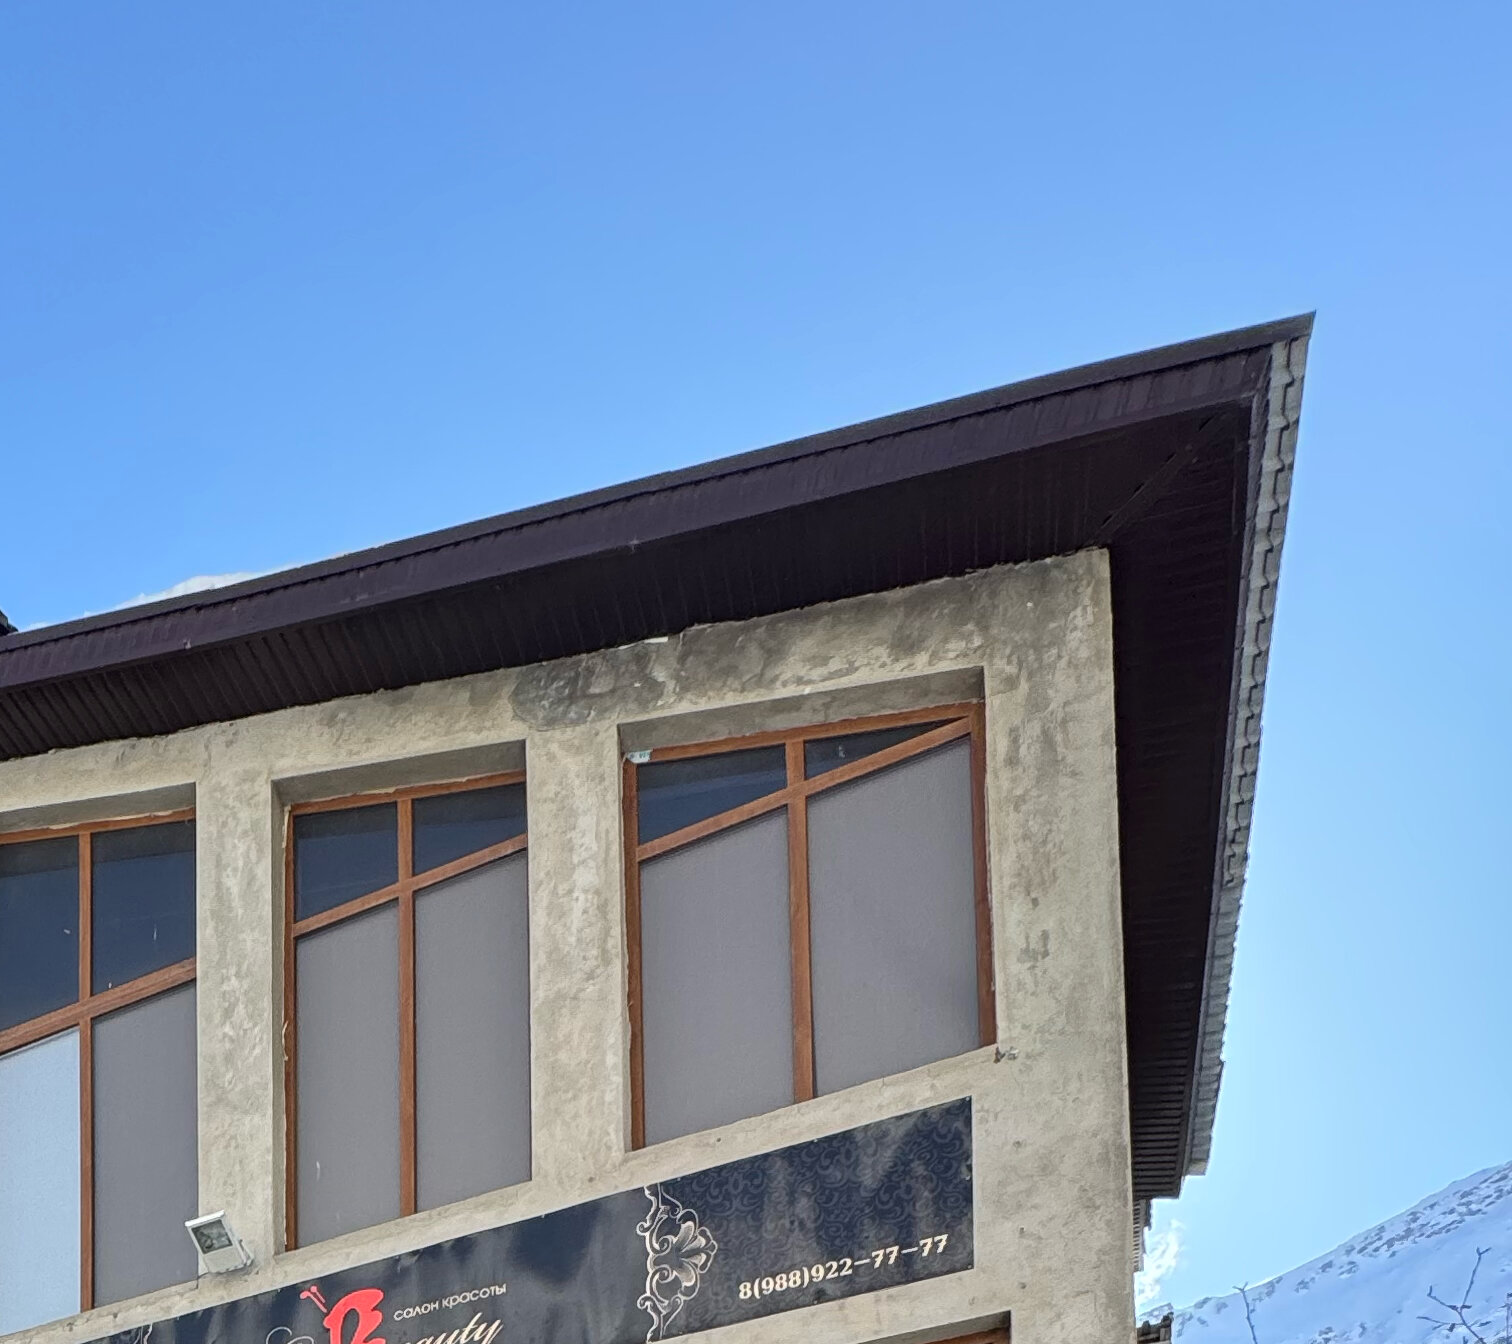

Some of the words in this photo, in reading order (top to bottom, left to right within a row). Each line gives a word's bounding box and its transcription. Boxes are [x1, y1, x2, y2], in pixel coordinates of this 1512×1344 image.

[738, 1234, 949, 1299] 8(988)922-77-77
[393, 1301, 439, 1321] салон
[441, 1283, 507, 1310] красоты
